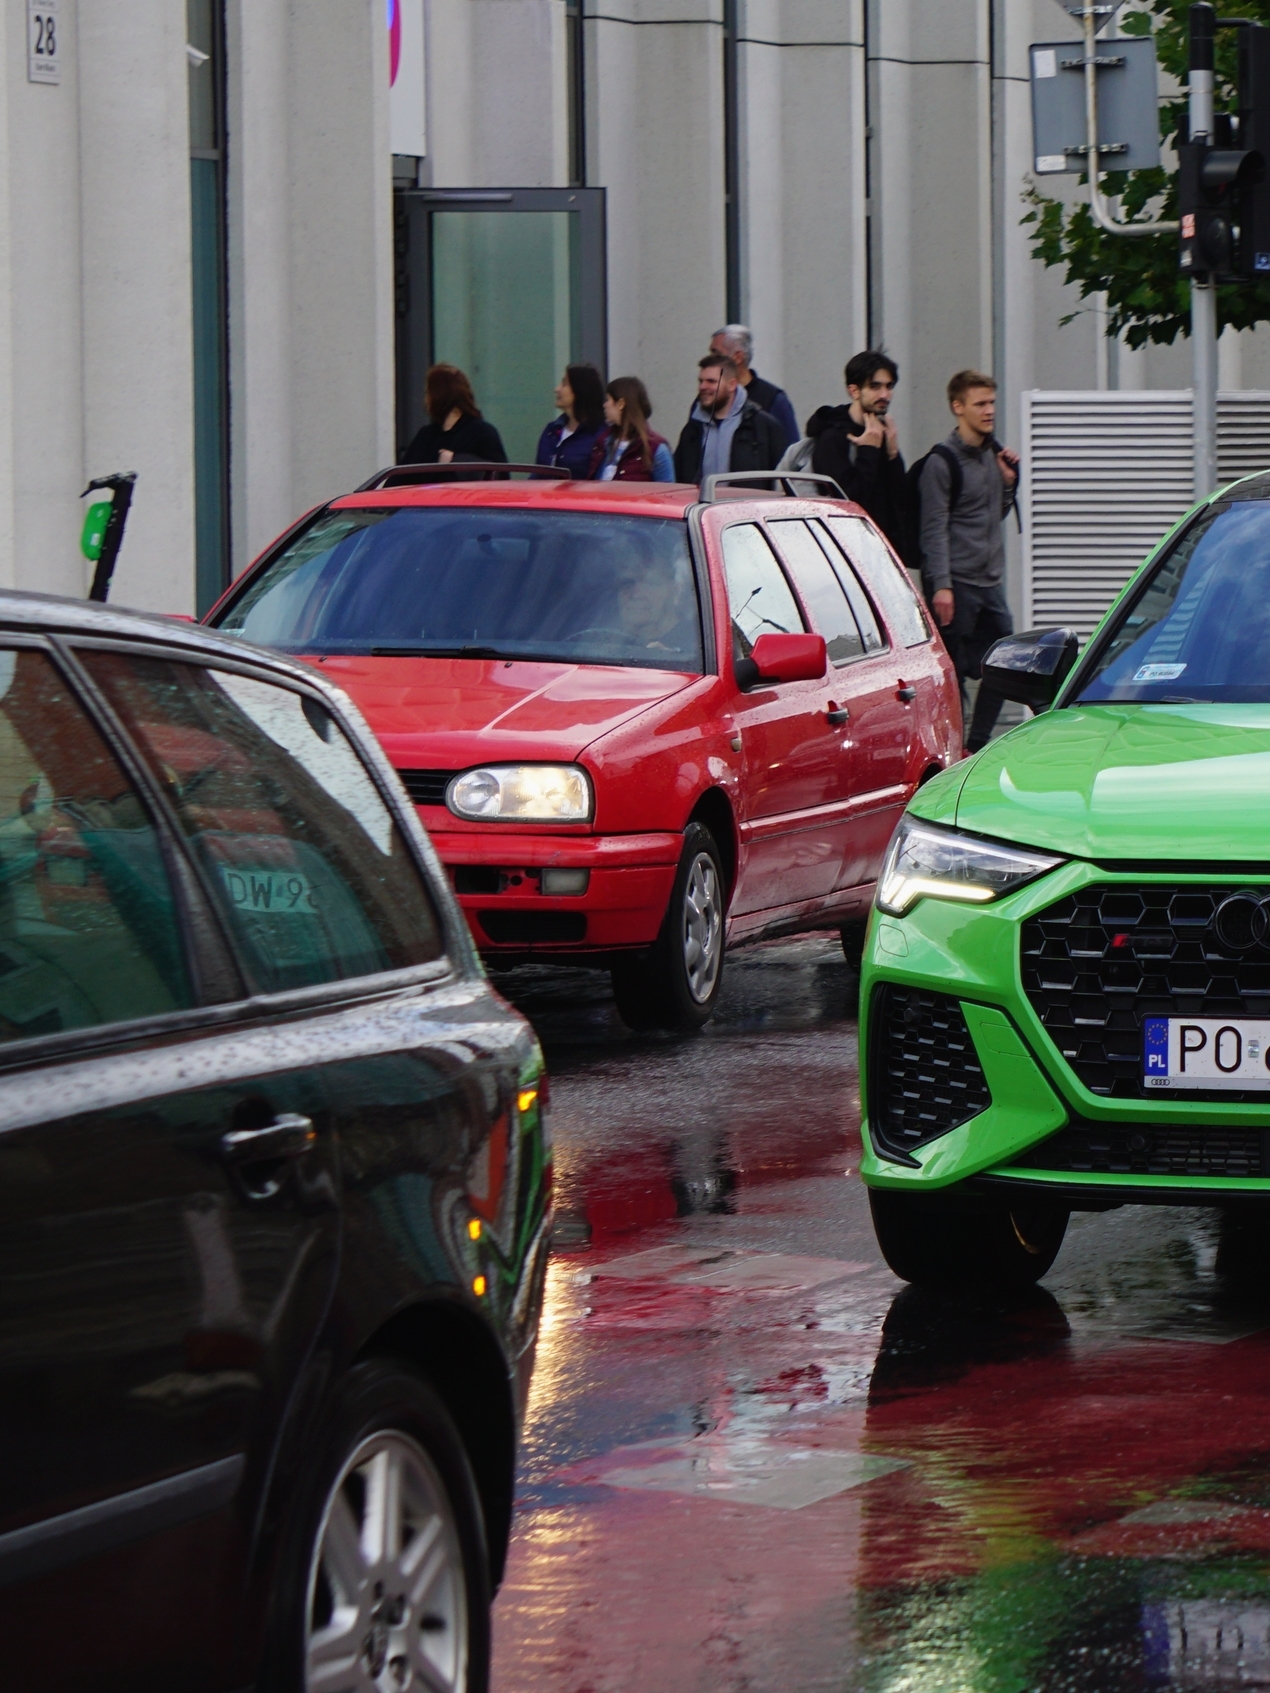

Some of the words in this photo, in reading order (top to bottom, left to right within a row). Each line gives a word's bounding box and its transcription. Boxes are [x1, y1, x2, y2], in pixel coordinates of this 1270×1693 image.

[34, 14, 56, 56] 28
[227, 872, 273, 909] DW
[1148, 1054, 1166, 1068] PL
[1180, 1025, 1242, 1073] PO
